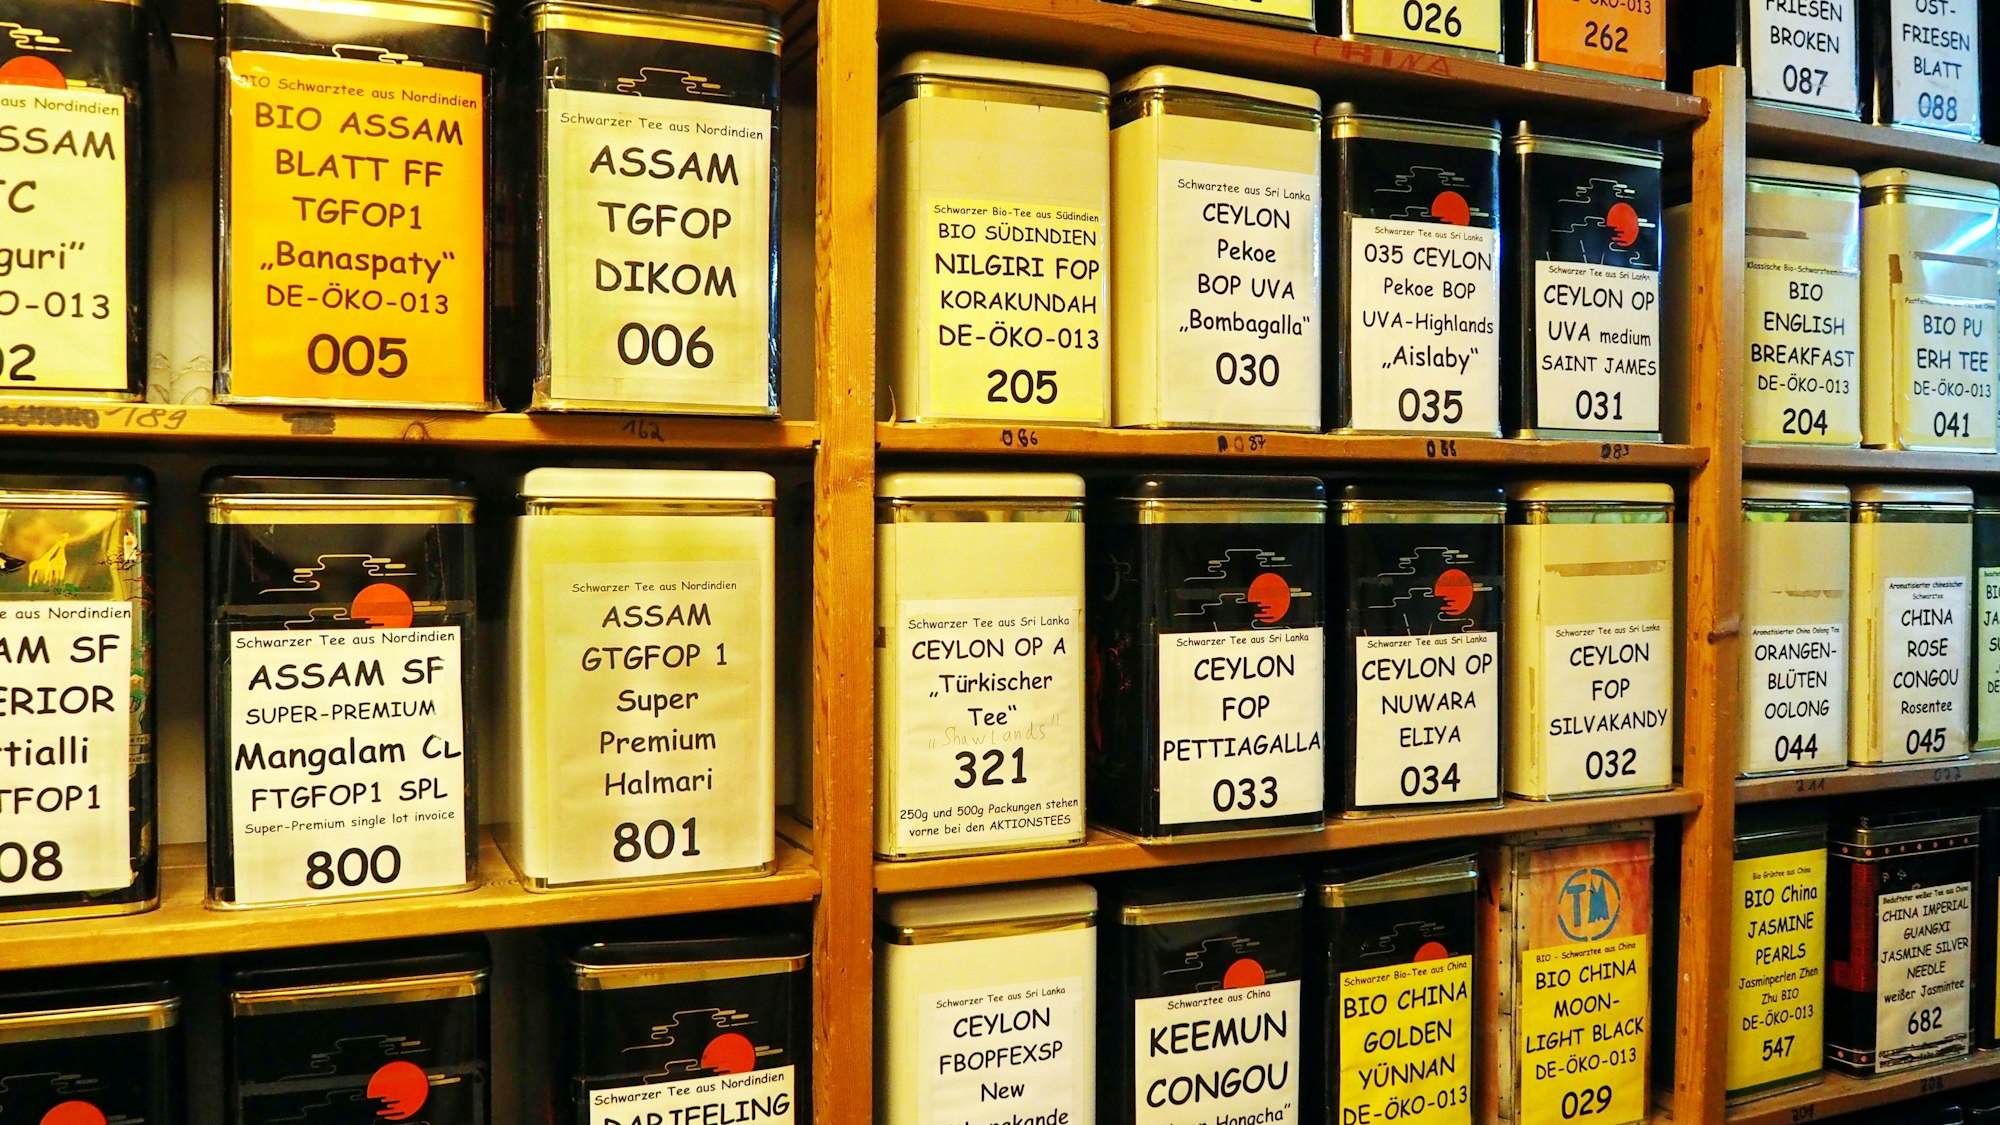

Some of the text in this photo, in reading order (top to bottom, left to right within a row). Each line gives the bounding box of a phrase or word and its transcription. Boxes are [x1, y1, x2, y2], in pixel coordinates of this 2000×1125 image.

[1403, 0, 1462, 38] 026
[1584, 20, 1628, 53] 262
[1770, 25, 1839, 54] BROKEN
[1902, 23, 1970, 52] FRIESEN
[1782, 64, 1828, 96] 087
[1914, 56, 1962, 80] BLATT
[1918, 92, 1958, 122] 088
[255, 102, 464, 146] BIO ASSAM
[276, 148, 444, 188] BLATT FF
[589, 145, 739, 186] ASSAM
[292, 196, 422, 230] TGFOP1
[597, 201, 732, 240] TGFOP
[1202, 202, 1290, 230] CEYLON
[938, 222, 1096, 246] BIO SÜDINDIEN
[1218, 238, 1276, 263] Pekoe
[1364, 243, 1492, 271] 035 CEYLON
[596, 258, 737, 298] DIKOM
[935, 252, 1100, 280] NILGIRI FOP
[267, 282, 448, 315] DE-ÖKO-013
[1198, 273, 1295, 300] BOP UVA
[1384, 277, 1476, 299] Pekoe BOP
[1544, 284, 1654, 311] CEYLON OP
[1789, 281, 1823, 302] BIO
[941, 290, 1096, 314] KORAKUNDAH
[939, 320, 1099, 350] DE-ÖKO-013
[1363, 310, 1494, 336] UVA-Highlands
[1548, 320, 1651, 346] UVA medium
[1764, 311, 1844, 335] ENGLISH
[1923, 314, 1983, 338] BIO PU
[307, 333, 408, 379] 005
[617, 322, 714, 369] 006
[1751, 343, 1854, 368] BREAKFAST
[1216, 352, 1280, 387] 030
[1542, 354, 1656, 376] SAINT JAMES
[1917, 348, 1989, 372] ERH TEE
[987, 369, 1058, 404] 205
[1758, 373, 1849, 394] DE-ÖKO-013
[1914, 378, 1992, 398] DE-ÖKO-013
[1398, 388, 1463, 424] 035
[1576, 390, 1623, 420] 031
[1782, 408, 1828, 436] 204
[1934, 411, 1970, 438] 041
[602, 602, 712, 628] ASSAM
[1901, 608, 1953, 627] CHINA
[582, 642, 727, 672] GTGFOP 1
[912, 636, 1066, 660] CEYLON OP A
[1570, 642, 1649, 667] CEYLON
[1754, 642, 1837, 661] ORANGEN-
[1908, 638, 1948, 658] ROSE
[248, 656, 444, 691] ASSAM SF
[1194, 654, 1294, 681] CEYLON
[1362, 653, 1492, 681] CEYLON OP
[1768, 668, 1827, 690] BLÜTEN
[1893, 668, 1959, 689] CONGOU
[616, 689, 699, 718] Super
[1382, 691, 1476, 715] NUWARA
[1592, 678, 1630, 701] FOP
[246, 700, 435, 725] SUPER-PREMIUM
[1222, 695, 1270, 722] FOP
[1764, 699, 1830, 720] OOLONG
[1901, 699, 1952, 715] Rosentee
[1549, 708, 1668, 736] SILVAKANDY
[600, 728, 716, 754] Premium
[1163, 731, 1321, 762] PETTIAGALLA
[1400, 725, 1461, 748] ELIYA
[1775, 733, 1818, 762] 044
[1906, 727, 1947, 755] 045
[234, 736, 406, 776] Mangalam
[954, 746, 1027, 789] 321
[1586, 748, 1636, 780] 032
[605, 768, 712, 796] Halmari
[1400, 762, 1461, 797] 034
[252, 777, 448, 812] FTGFOP1 SPL
[1213, 776, 1278, 812] 033
[244, 810, 455, 836] Super-Premium single lot invoice
[900, 797, 1079, 822] 250g und 500g Packungen stehen
[613, 816, 700, 863] 801
[909, 814, 1071, 837] vorne bei den AKTIONSTEES
[306, 844, 401, 890] 800
[1744, 884, 1818, 909] BIO China
[1882, 898, 1969, 922] CHINA IMPERIAL
[1748, 911, 1814, 939] JASMINE
[1756, 942, 1806, 966] PEARLS
[1880, 936, 1969, 964] JASMINE SILVER
[1536, 959, 1637, 990] BIO CHINA
[1737, 970, 1796, 990] Jasminperlen
[1344, 980, 1468, 1019] BIO CHINA
[1554, 992, 1620, 1019] MOON-
[1781, 987, 1800, 1001] BIO
[1884, 979, 1965, 1004] weißer Jasmintee
[953, 1007, 1050, 1038] CEYLON
[1742, 1004, 1814, 1032] DE-ÖKO-013
[1908, 1006, 1942, 1035] 682
[1150, 1010, 1287, 1058] KEEMUN
[1364, 1018, 1452, 1054] GOLDEN
[1526, 1016, 1644, 1054] LIGHT BLACK
[940, 1040, 1063, 1075] FBOPFEXSP
[1762, 1035, 1795, 1062] 547
[1358, 1053, 1455, 1090] YÜNNAN
[1536, 1047, 1636, 1080] DE-ÖKO-013
[981, 1082, 1025, 1102] New
[1146, 1060, 1291, 1109] CONGOU
[1343, 1085, 1468, 1125] DE-ÖKO-013
[1561, 1085, 1612, 1120] 029
